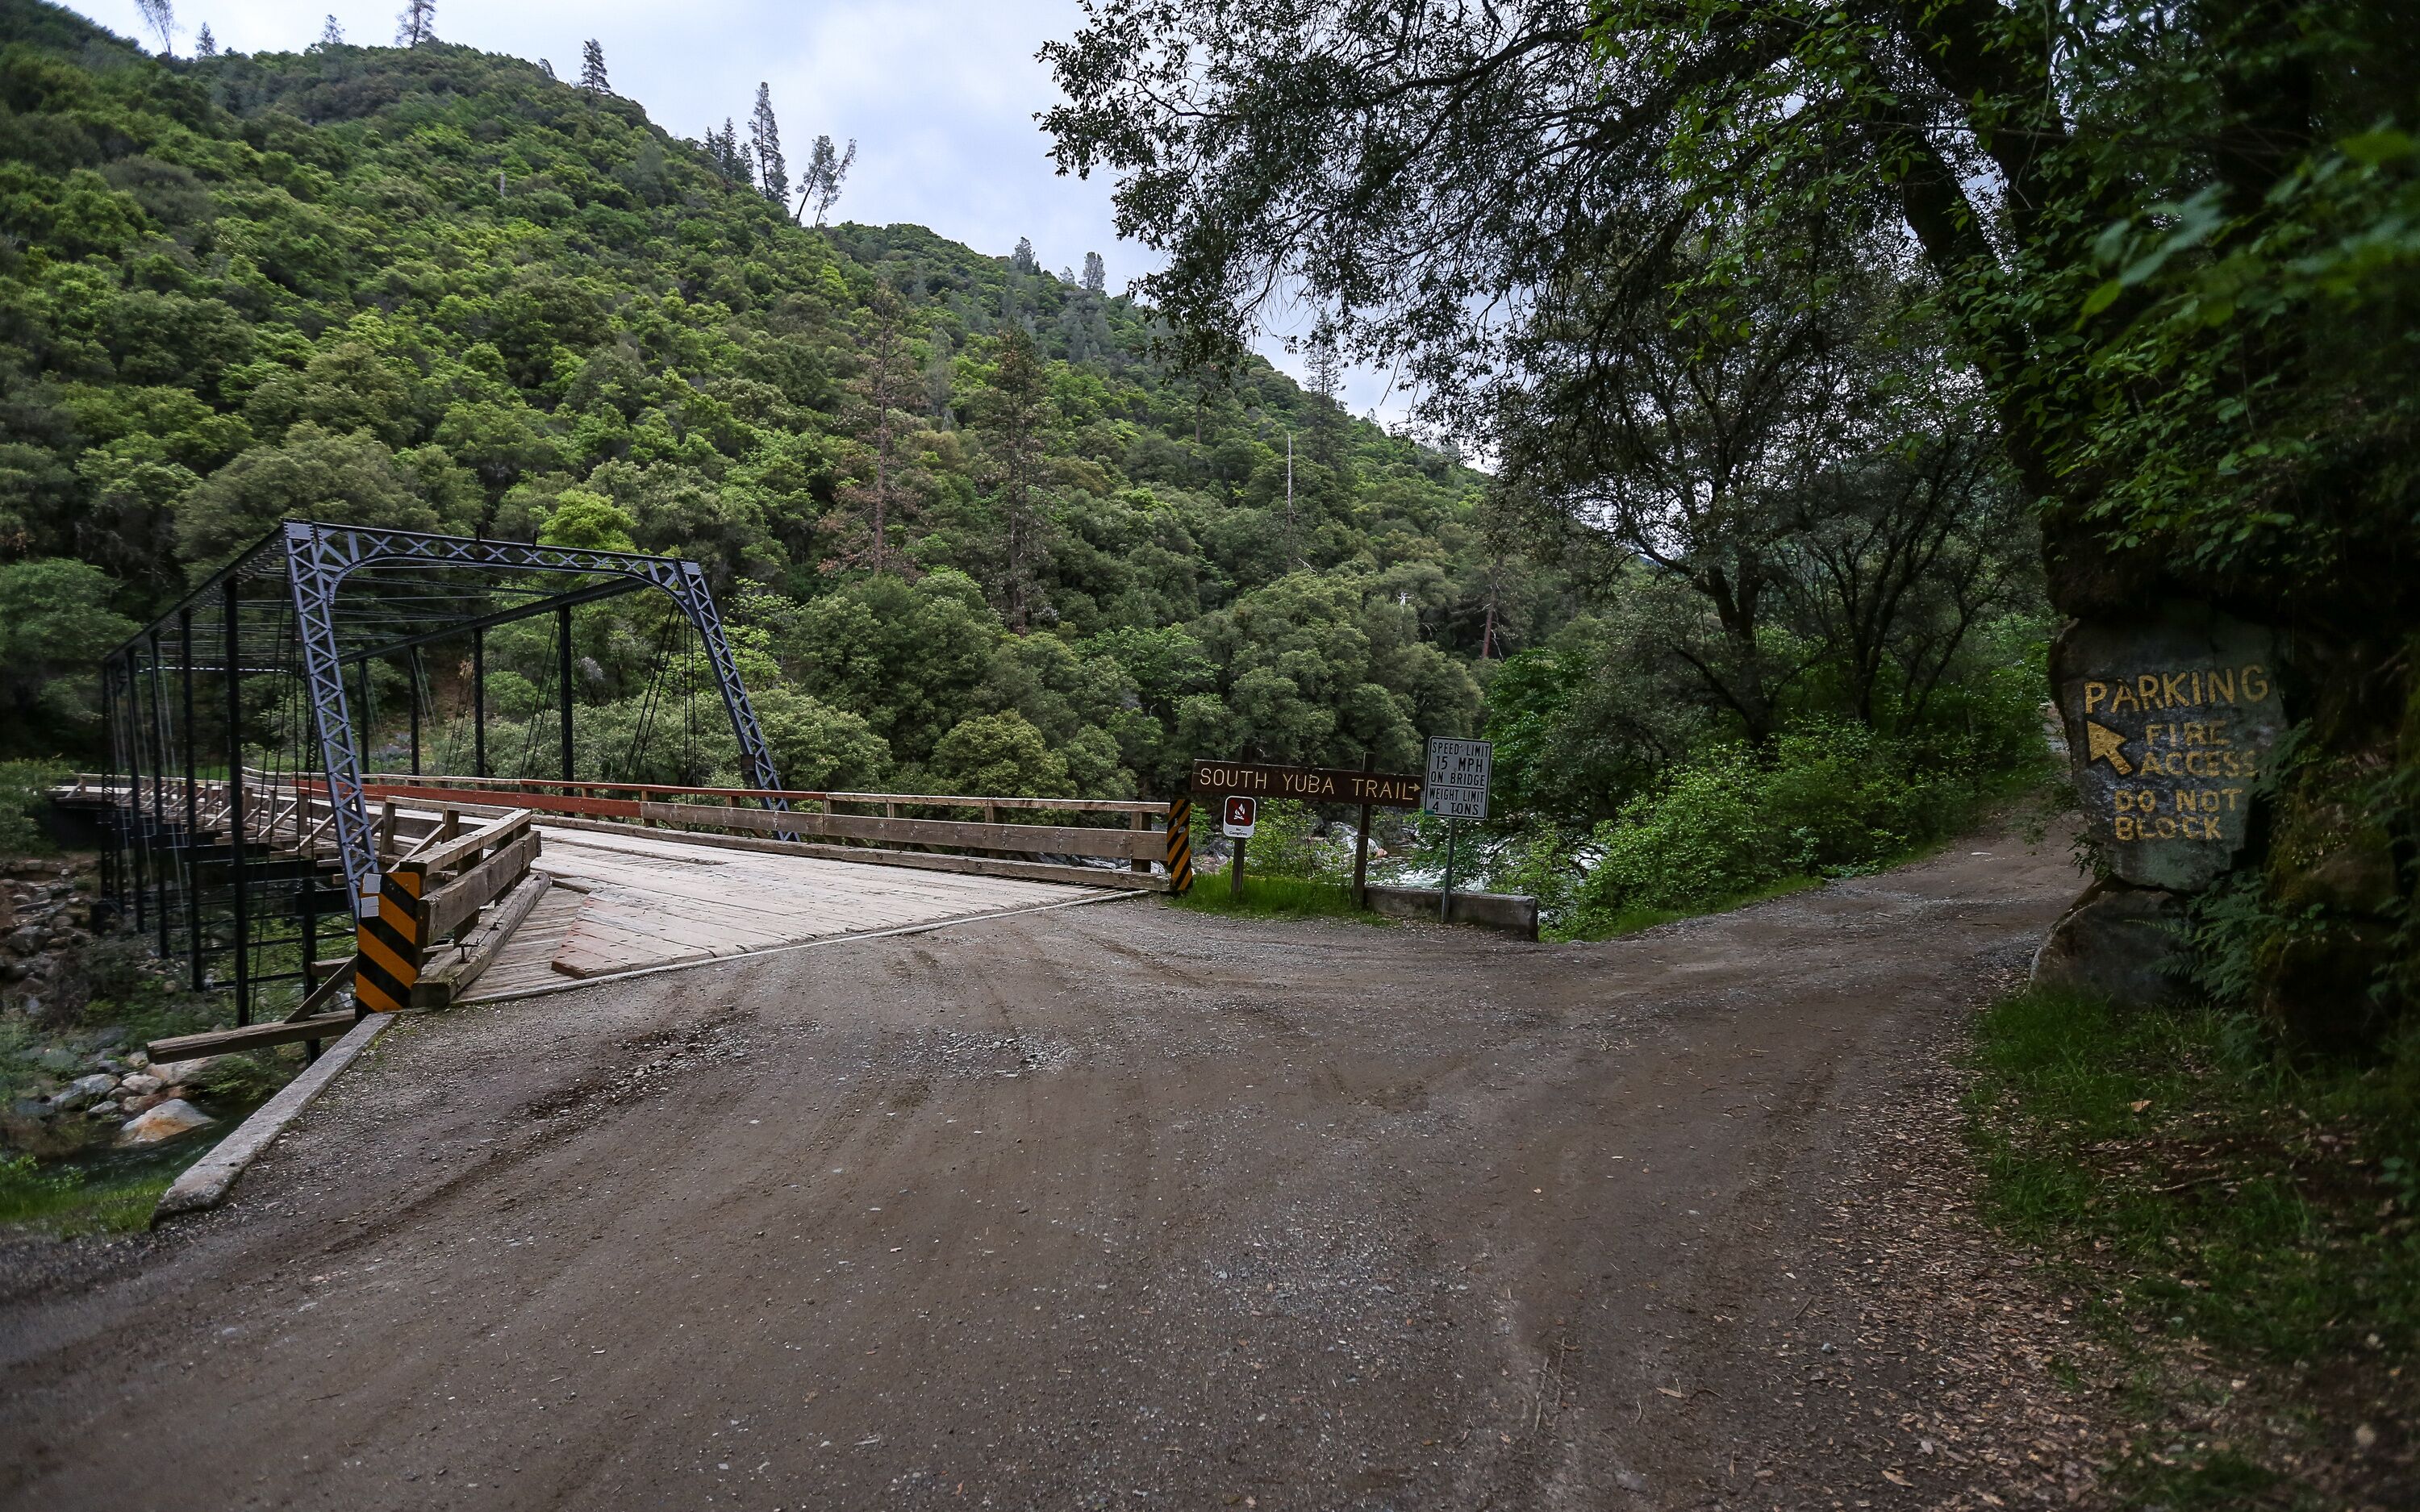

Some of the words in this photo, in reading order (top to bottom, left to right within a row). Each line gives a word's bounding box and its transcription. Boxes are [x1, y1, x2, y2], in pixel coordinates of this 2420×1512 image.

[2084, 664, 2268, 714] PARKING
[2146, 720, 2230, 747] FIRE
[1432, 742, 1459, 755] SPEED
[1467, 744, 1489, 757] LIMIT
[1437, 756, 1448, 769] 15
[1458, 757, 1483, 773] MPH
[2139, 750, 2257, 778] ACCESS
[1200, 768, 1267, 789] SOUTH
[1283, 773, 1335, 794] YUBA
[1351, 778, 1413, 801] TRAIL
[1430, 771, 1443, 783] ON
[1450, 773, 1485, 786] BRIDGE
[1429, 787, 1458, 801] WEIGHT
[1463, 790, 1484, 802] LIMIT
[2114, 789, 2156, 813] DO
[2176, 787, 2244, 812] NOT
[1432, 802, 1439, 813] 4
[1450, 802, 1479, 815] TONS
[2114, 816, 2222, 841] BLOCK
